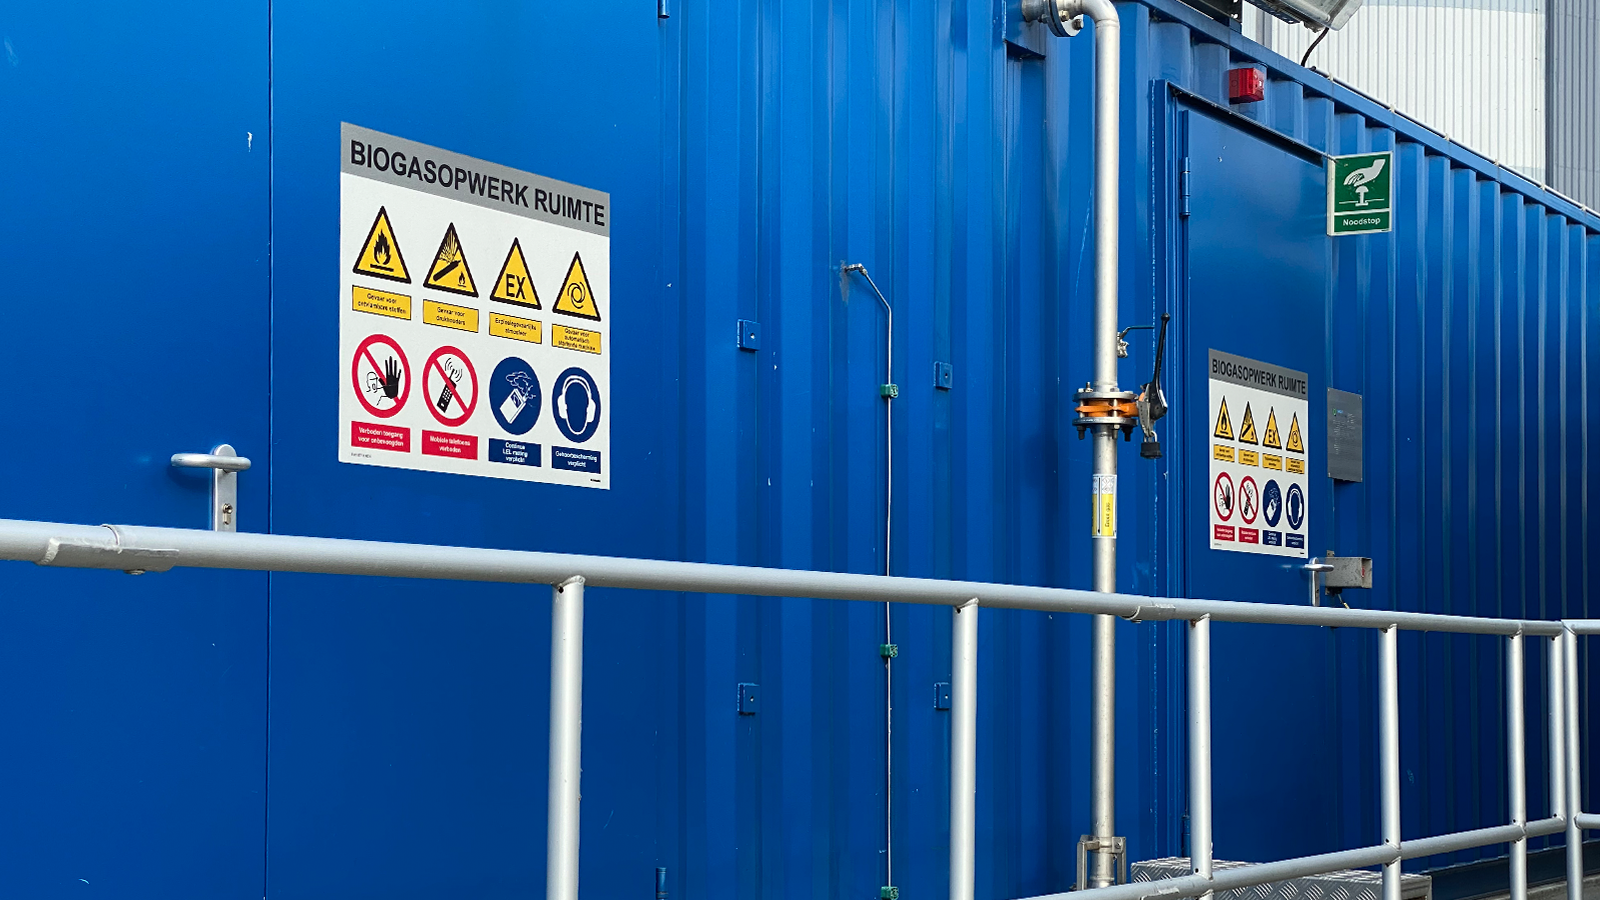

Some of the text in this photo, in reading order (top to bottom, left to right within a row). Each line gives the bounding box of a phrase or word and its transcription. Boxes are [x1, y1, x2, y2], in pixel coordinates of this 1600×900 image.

[350, 139, 606, 227] BIOGASOPWERK RUIMTE
[1342, 217, 1381, 226] Noodstop
[505, 274, 527, 300] EX
[367, 293, 385, 302] Gevaar
[437, 306, 454, 315] Gevaar
[1212, 358, 1306, 395] BIOGASOPWERK RUIMTE
[358, 426, 404, 440] Verboden toegang
[429, 435, 449, 444] Mobiele
[439, 445, 462, 453] verboden
[505, 441, 526, 450] Continue
[505, 455, 525, 463] verplicht
[555, 450, 598, 462] Gehoorbescherming
[567, 460, 587, 468] verplicht
